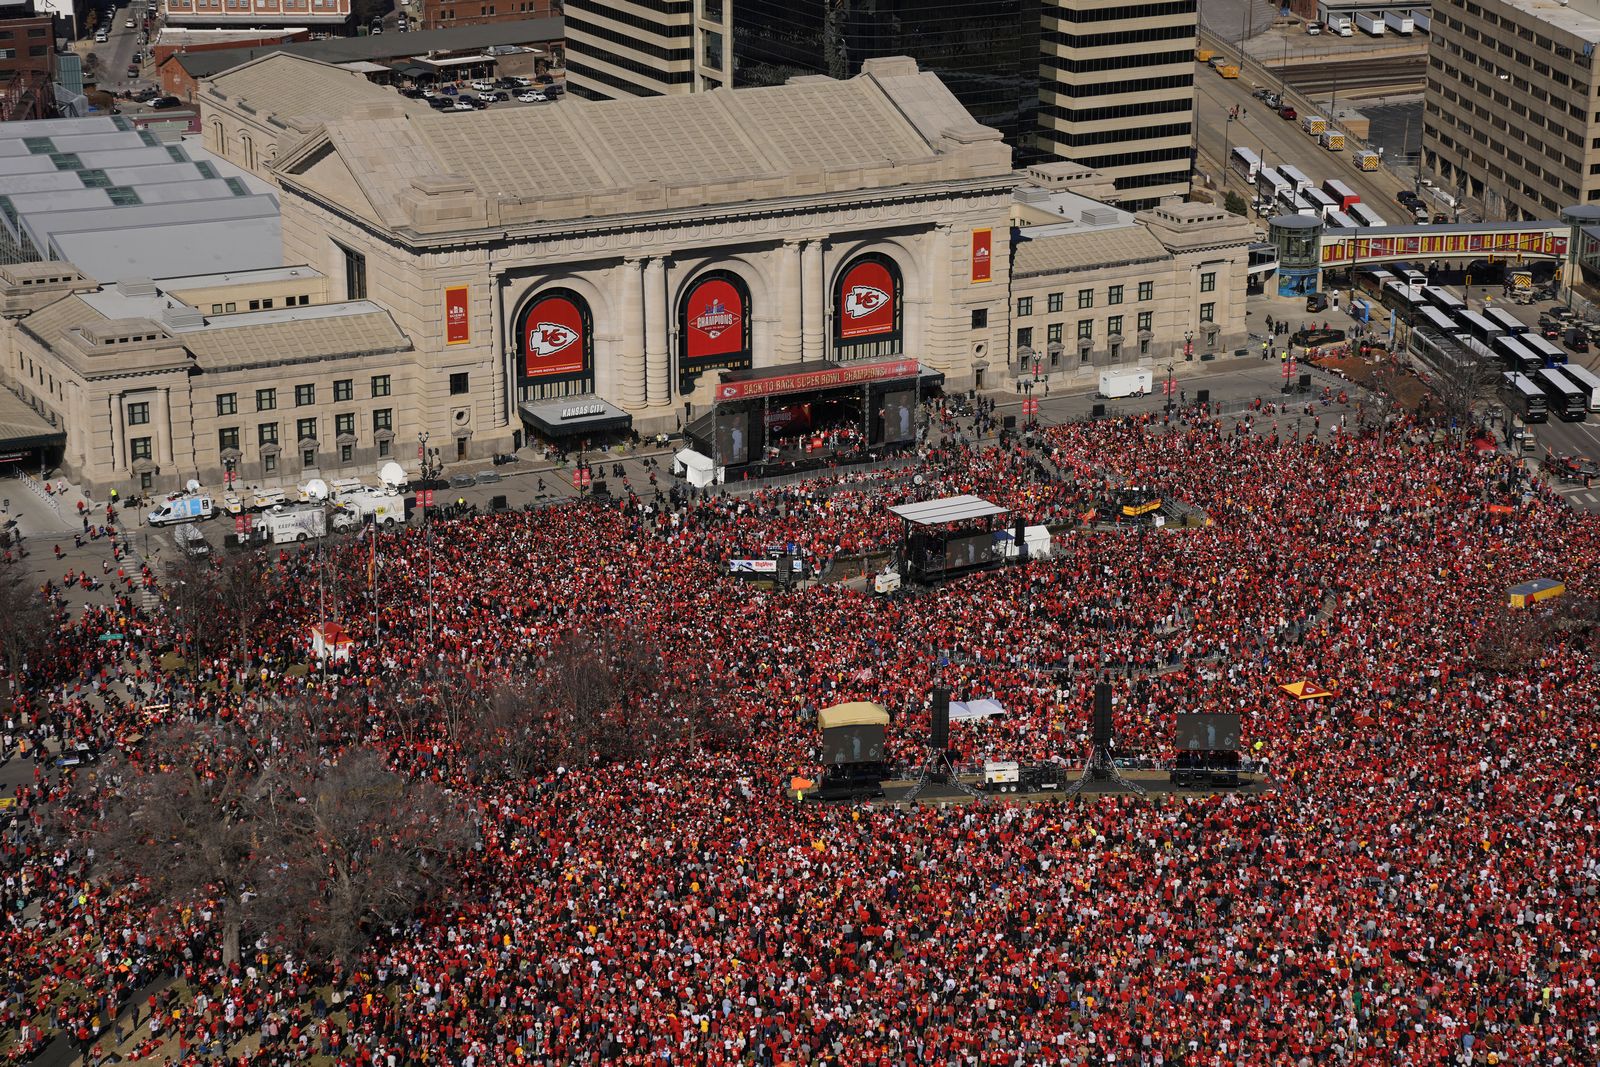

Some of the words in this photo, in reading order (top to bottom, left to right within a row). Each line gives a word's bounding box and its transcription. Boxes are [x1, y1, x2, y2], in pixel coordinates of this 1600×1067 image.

[1422, 236, 1466, 252] BACK
[1484, 234, 1553, 252] CHAMPS
[697, 313, 733, 329] CHAMPIONS
[797, 374, 820, 388] SUPER
[821, 372, 841, 385] BOWL
[843, 366, 886, 382] CHAMPIONS
[562, 405, 588, 418] KANSAS
[590, 404, 605, 415] CITY
